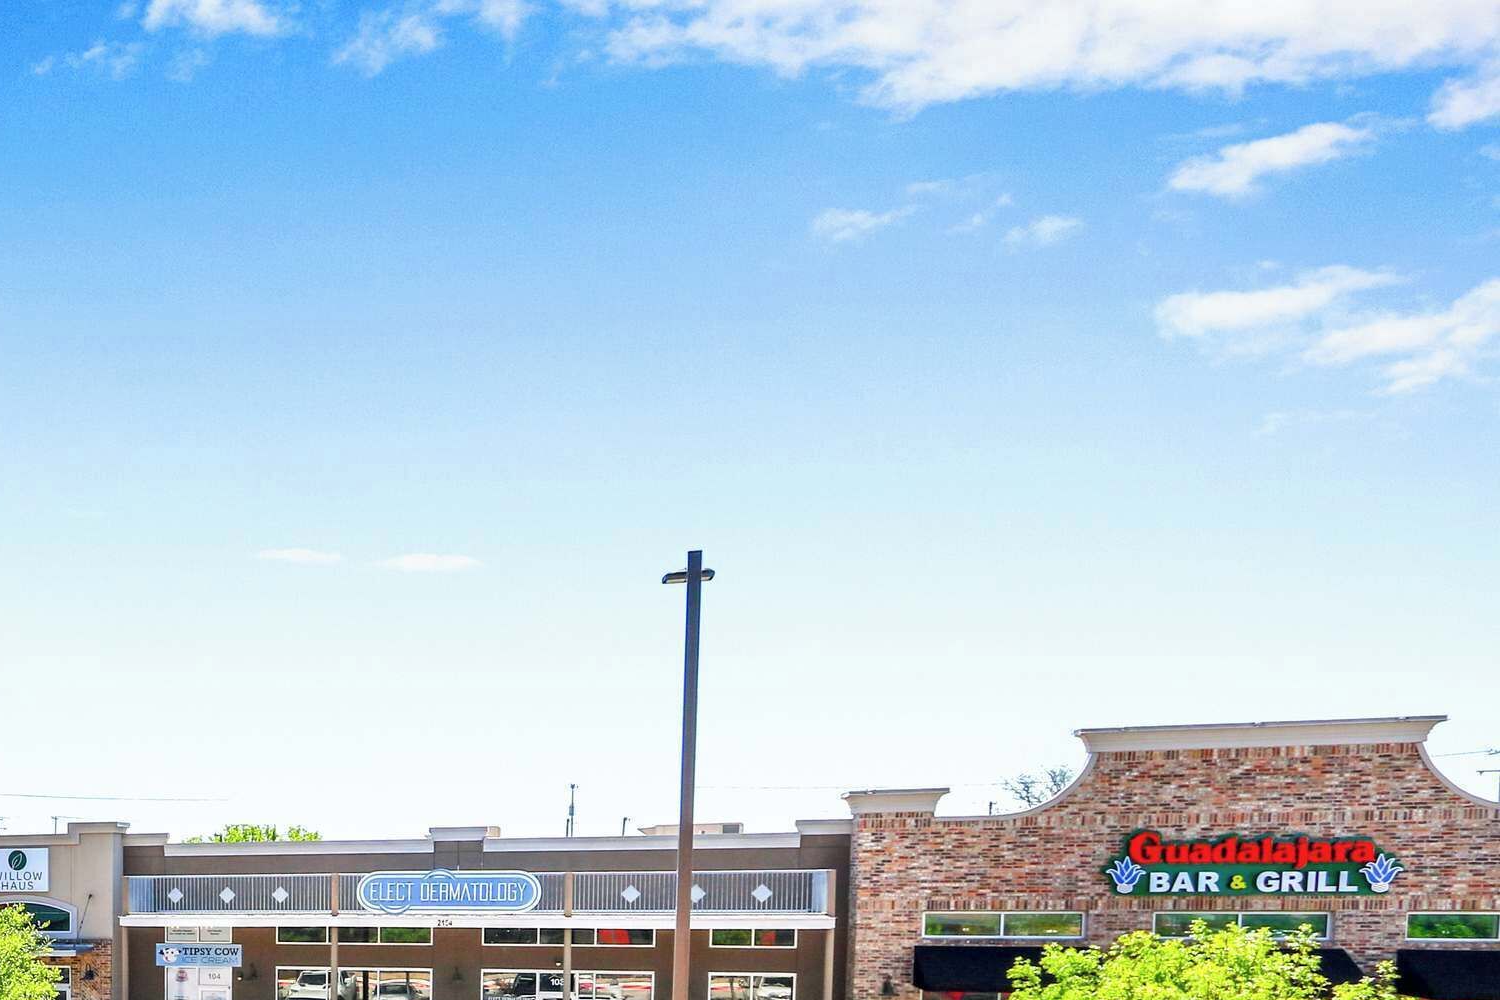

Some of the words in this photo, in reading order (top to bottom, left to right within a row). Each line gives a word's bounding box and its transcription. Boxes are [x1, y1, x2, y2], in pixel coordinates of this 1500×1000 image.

[1128, 831, 1375, 868] Guadalajara
[1, 881, 34, 890] HAUS
[1149, 872, 1220, 892] BAR
[1229, 875, 1247, 889] &
[1256, 871, 1358, 892] GRILL
[370, 882, 415, 901] ELECT
[420, 882, 527, 902] DERMATOLOGY
[182, 947, 212, 955] TIPSY
[214, 947, 239, 956] COW
